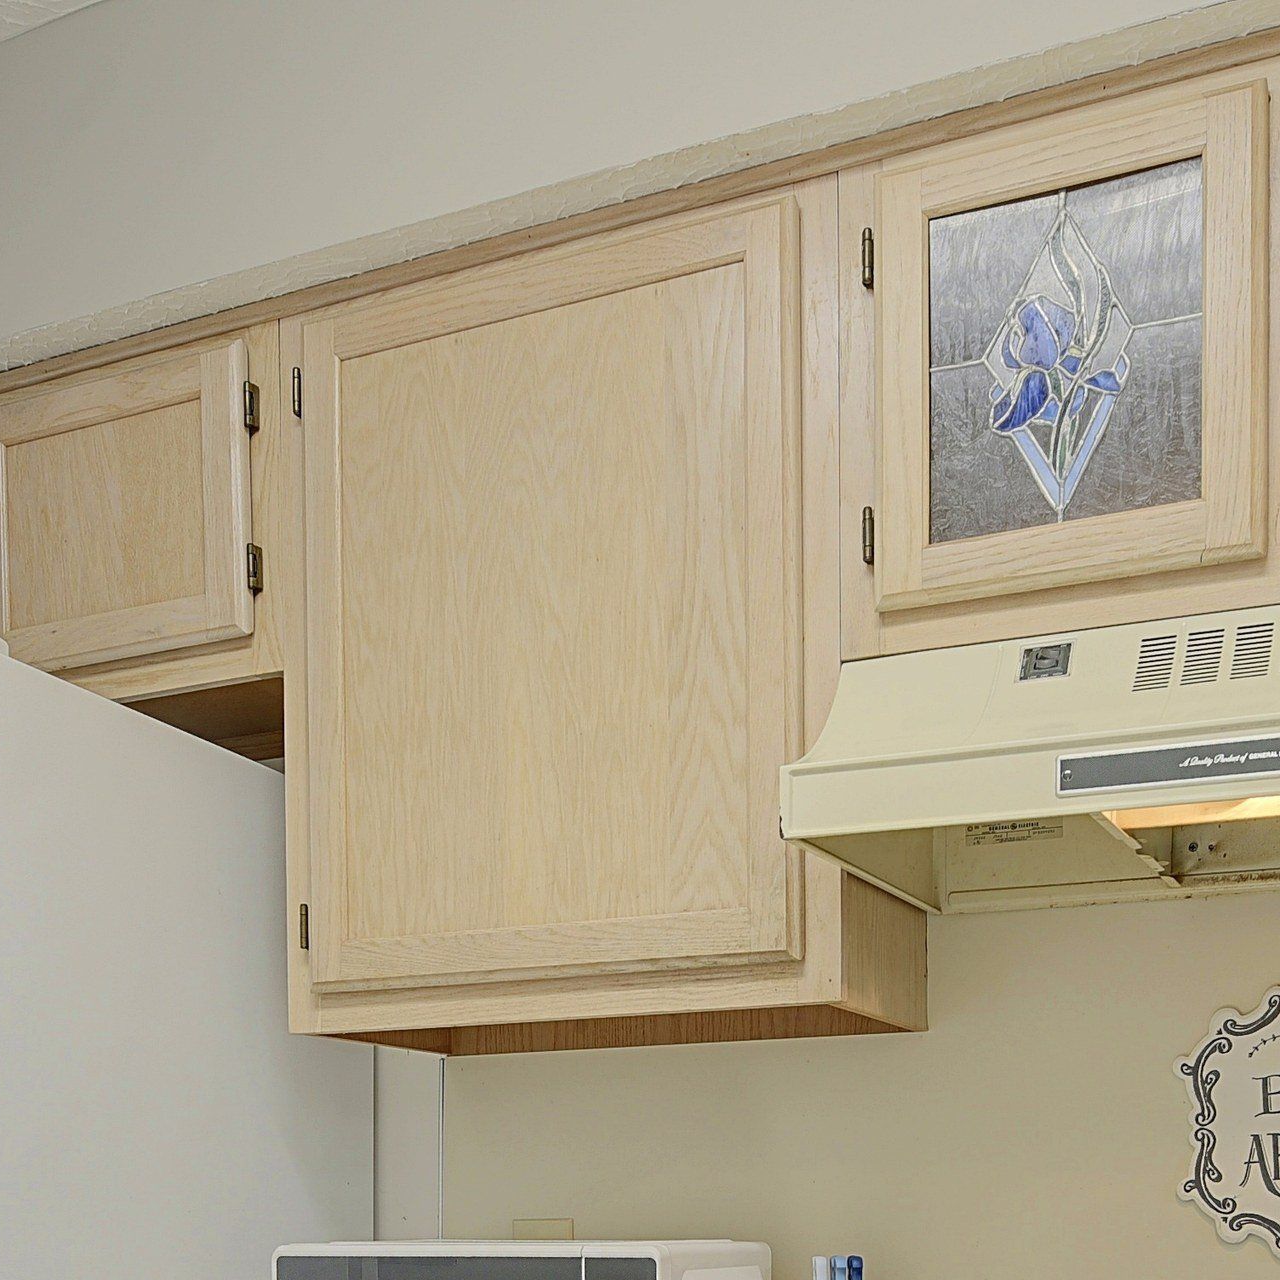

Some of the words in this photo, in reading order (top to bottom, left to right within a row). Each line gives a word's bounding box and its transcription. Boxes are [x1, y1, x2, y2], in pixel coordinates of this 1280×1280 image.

[1190, 756, 1214, 768] Quality
[1214, 753, 1241, 764] Product
[1239, 752, 1249, 764] of
[1248, 751, 1279, 760] GENERAL
